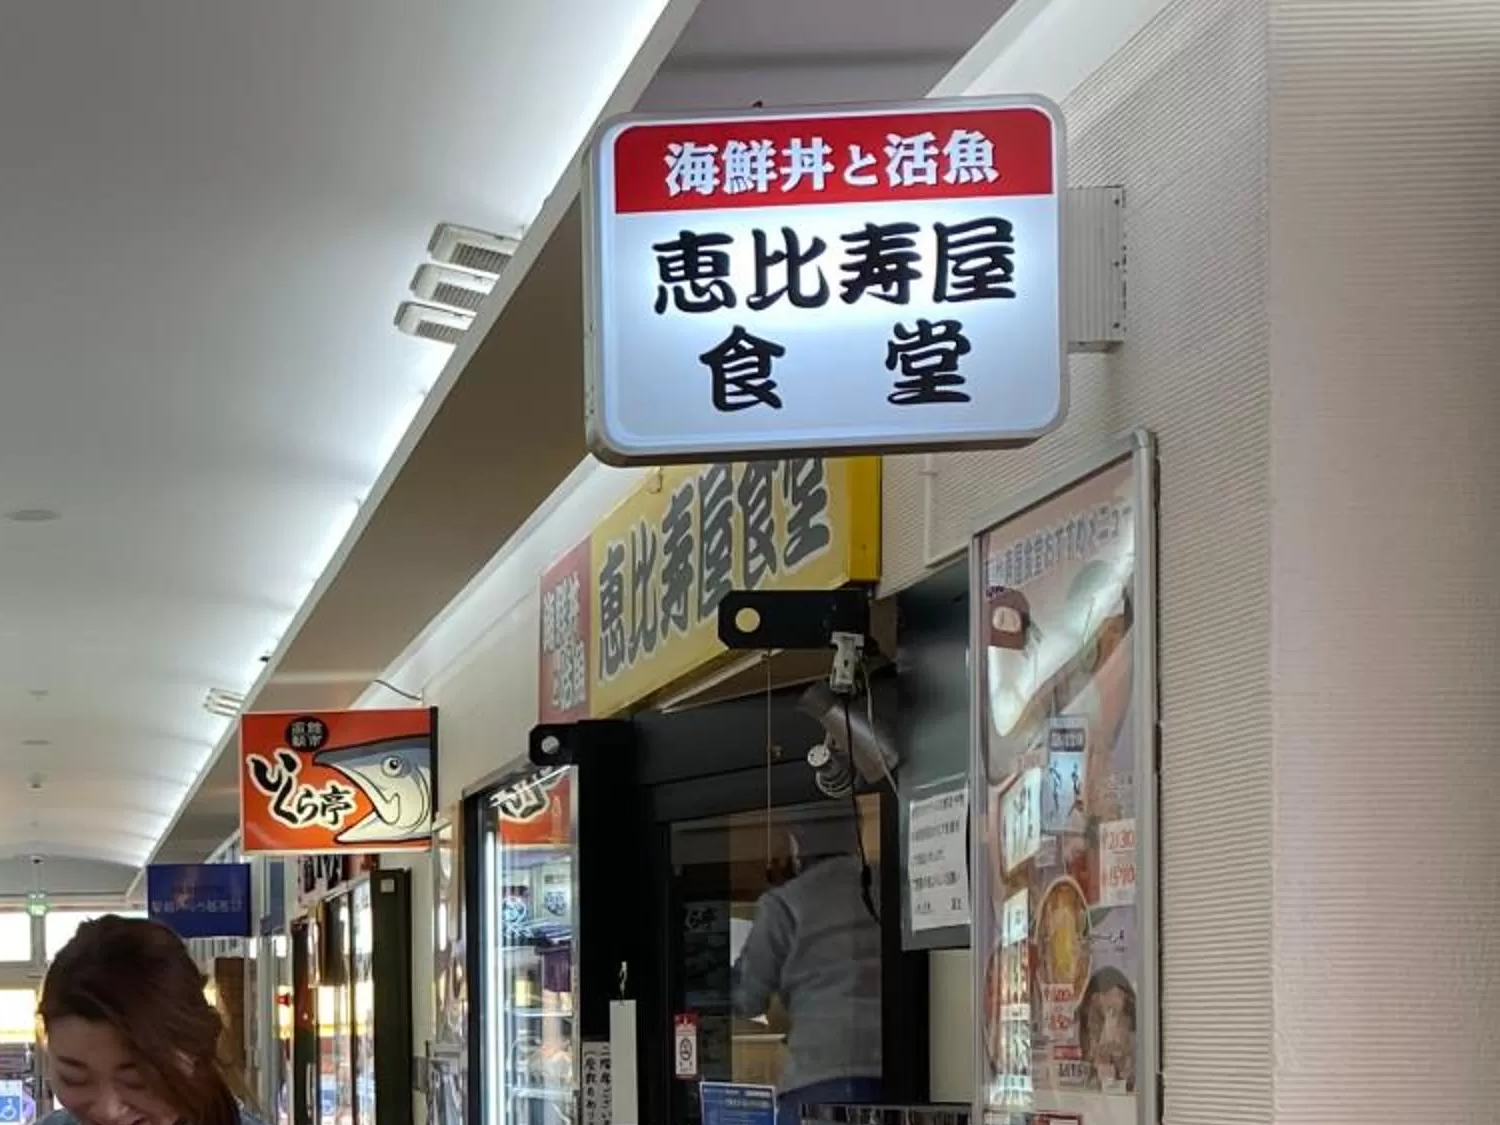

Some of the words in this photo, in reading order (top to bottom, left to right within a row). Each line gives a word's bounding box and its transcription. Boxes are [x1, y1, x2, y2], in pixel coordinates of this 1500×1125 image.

[663, 128, 1000, 197] 海鮮丼と活魚
[651, 217, 1017, 316] 恵比寿屋
[699, 318, 972, 412] 食堂
[599, 458, 831, 684] 恵比寿屋食堂
[248, 751, 354, 826] いくら亭
